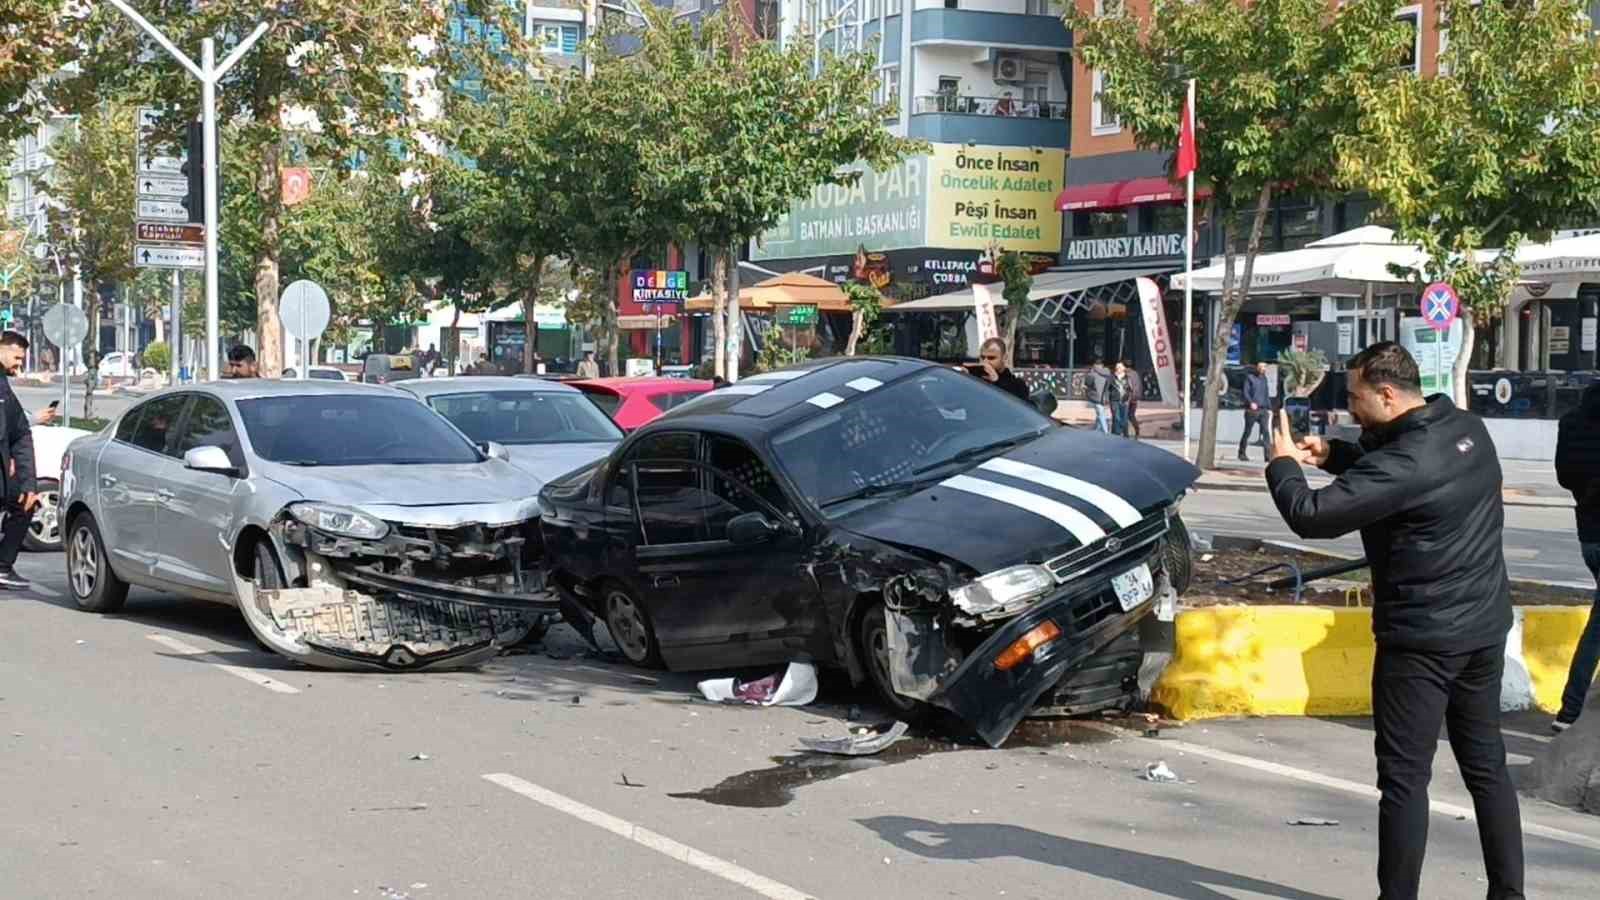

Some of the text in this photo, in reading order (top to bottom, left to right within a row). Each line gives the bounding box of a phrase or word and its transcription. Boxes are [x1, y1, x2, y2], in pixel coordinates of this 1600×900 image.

[955, 150, 1039, 172] Önce İnsan
[941, 169, 1053, 192] Öncelik Adalet
[801, 221, 842, 240] BATMAN
[856, 205, 920, 238] BAŞKANLIĞI
[992, 224, 1040, 239] Edalet
[1068, 233, 1181, 260] ARTUKBEY KAHVE
[925, 259, 977, 273] KELLEPAÇA
[933, 272, 968, 284] ÇORBA
